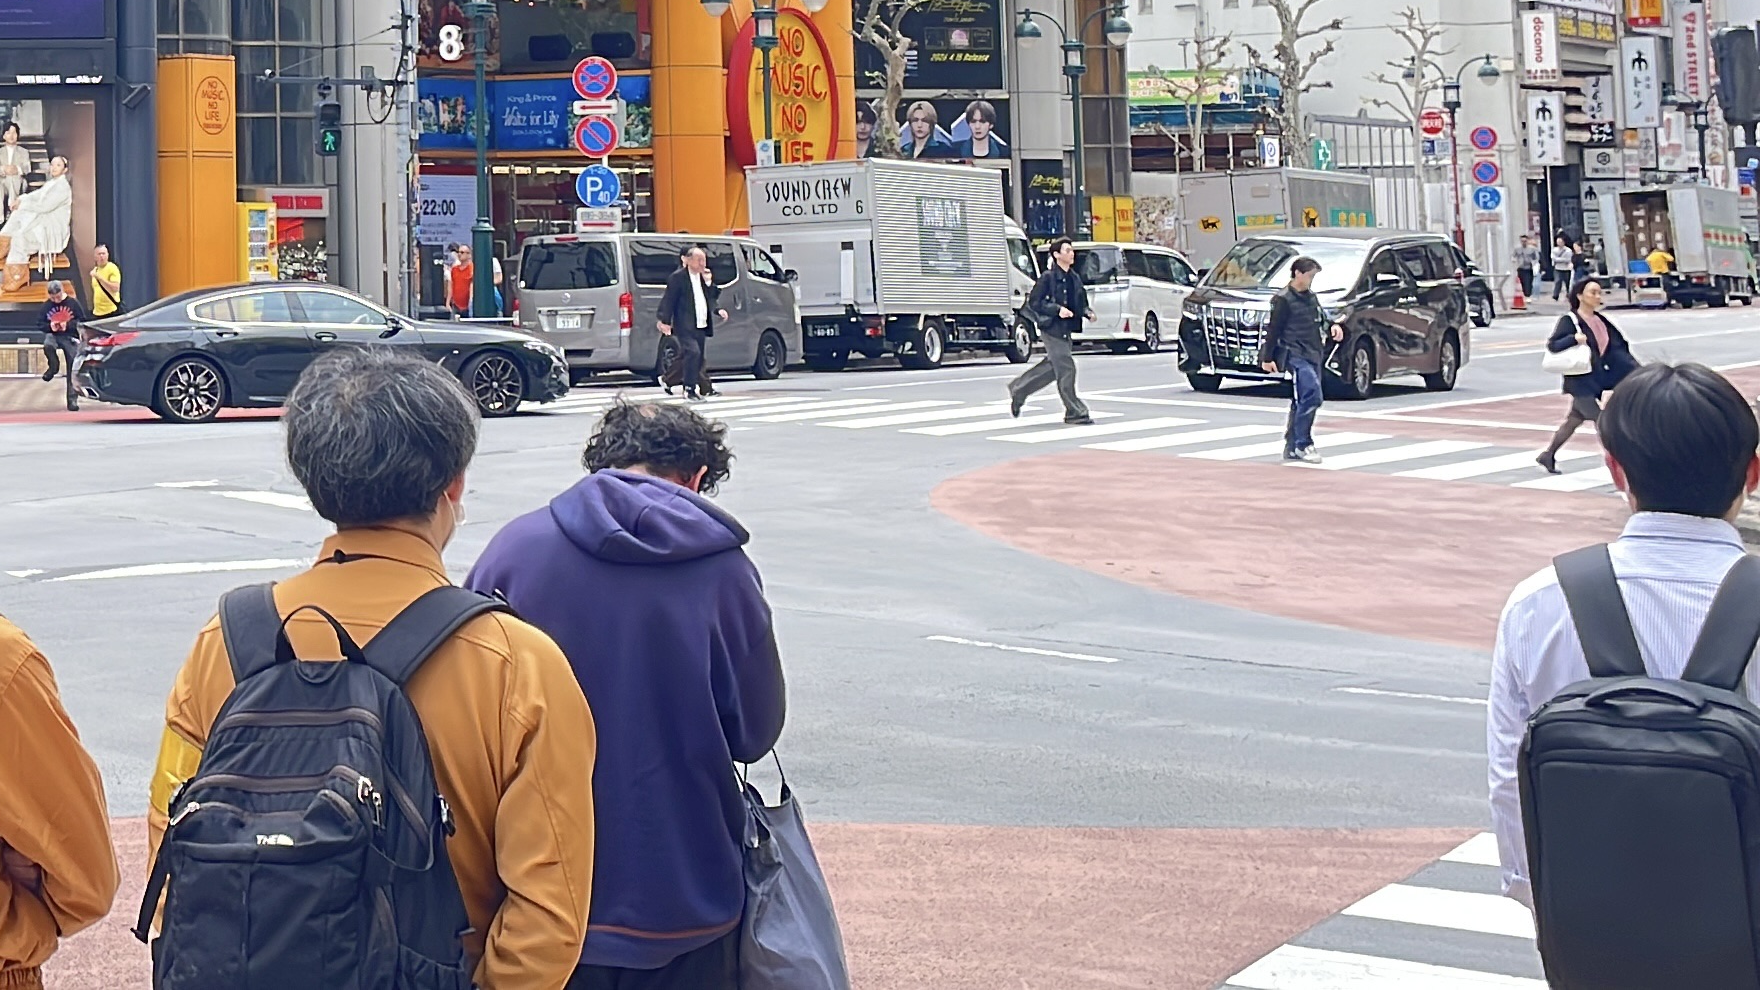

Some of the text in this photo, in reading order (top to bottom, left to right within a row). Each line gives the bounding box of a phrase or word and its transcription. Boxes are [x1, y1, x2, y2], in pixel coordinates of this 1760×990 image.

[439, 24, 464, 61] 8
[780, 28, 805, 57] NO
[1532, 16, 1544, 63] docomo
[1684, 27, 1699, 97] 2nd STREET
[207, 80, 218, 89] NO
[207, 101, 218, 110] NO
[543, 110, 560, 129] Lily
[781, 103, 807, 133] NO
[586, 176, 603, 203] P
[597, 190, 610, 203] 40
[765, 177, 852, 203] SOUND CREW
[1478, 192, 1490, 206] P
[782, 203, 838, 217] CO. LTD
[855, 200, 863, 215] 6
